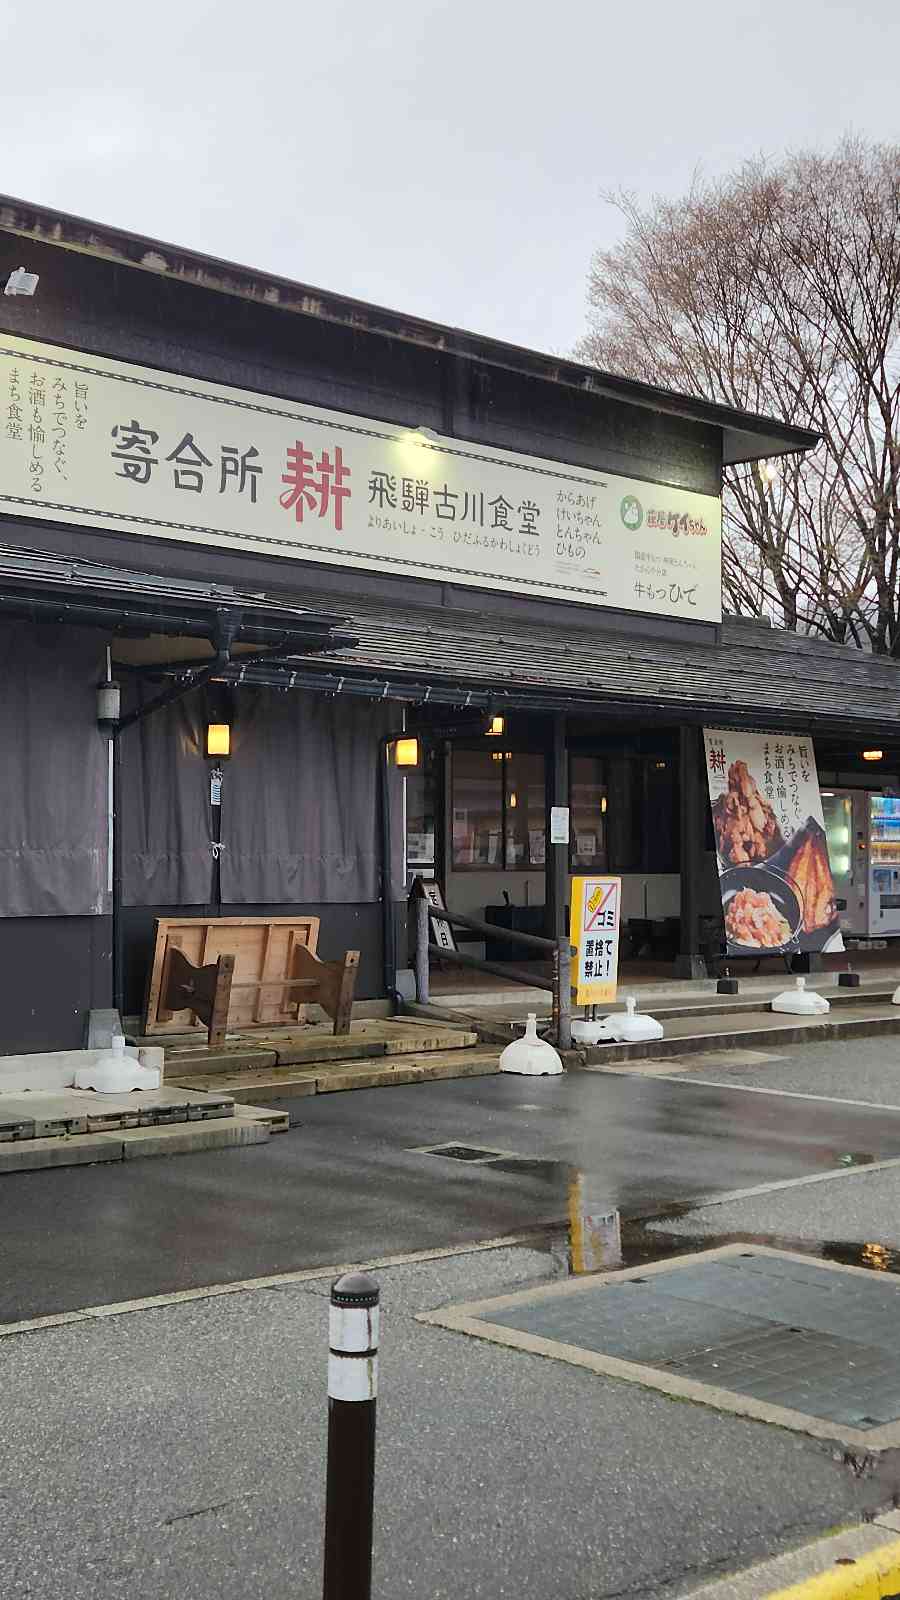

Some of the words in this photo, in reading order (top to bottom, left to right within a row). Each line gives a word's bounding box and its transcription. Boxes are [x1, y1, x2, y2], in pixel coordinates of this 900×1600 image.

[6, 367, 23, 440] まち食堂
[74, 381, 89, 430] 旨いを
[29, 371, 46, 492] お酒も愉しめる
[111, 420, 263, 503] 寄合所
[279, 440, 351, 530] 耕
[368, 470, 540, 536] 飛騨古川食堂
[556, 490, 597, 509] からあげ
[556, 508, 602, 528] けいちゃん
[556, 524, 602, 545] とんちゃん
[556, 543, 586, 558] ひもの
